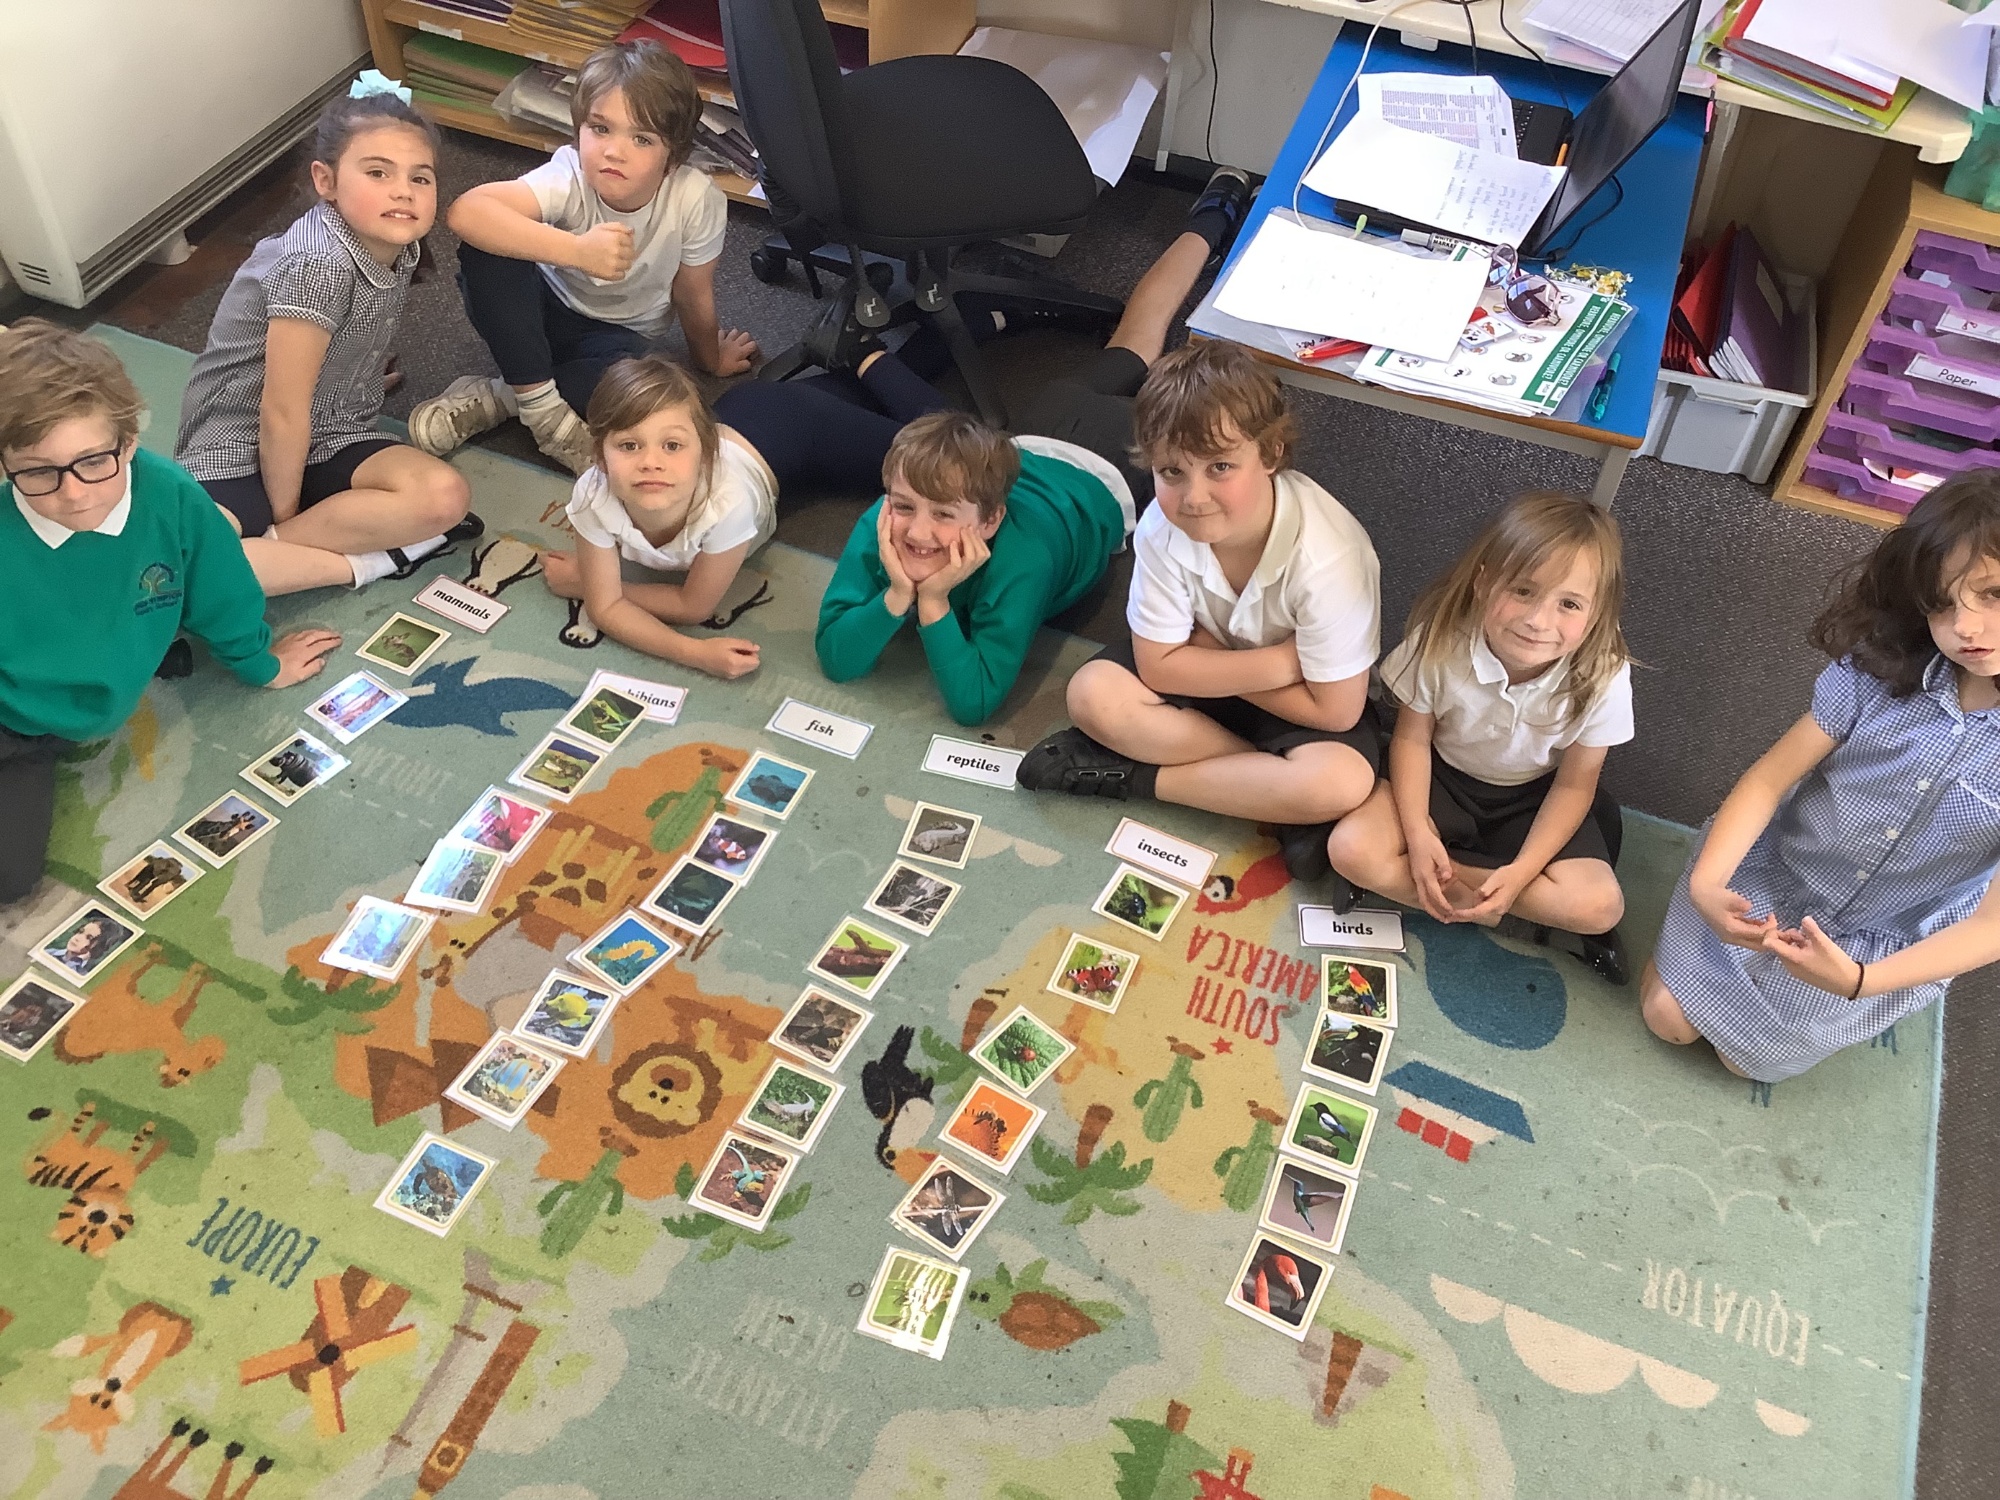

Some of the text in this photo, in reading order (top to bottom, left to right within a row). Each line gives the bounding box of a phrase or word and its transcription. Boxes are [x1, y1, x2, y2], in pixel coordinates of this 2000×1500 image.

[1937, 368, 1978, 387] Paper
[432, 588, 492, 621] mammals
[626, 688, 678, 709] hibians
[804, 719, 835, 737] fish
[946, 752, 1001, 774] reptiles
[1136, 838, 1189, 868] insects
[1332, 920, 1374, 937] birds
[1185, 924, 1321, 1003] AMERICA
[1185, 975, 1289, 1046] SOUTH
[186, 1196, 321, 1290] EUROPE
[1642, 1258, 1810, 1366] EQUATOR
